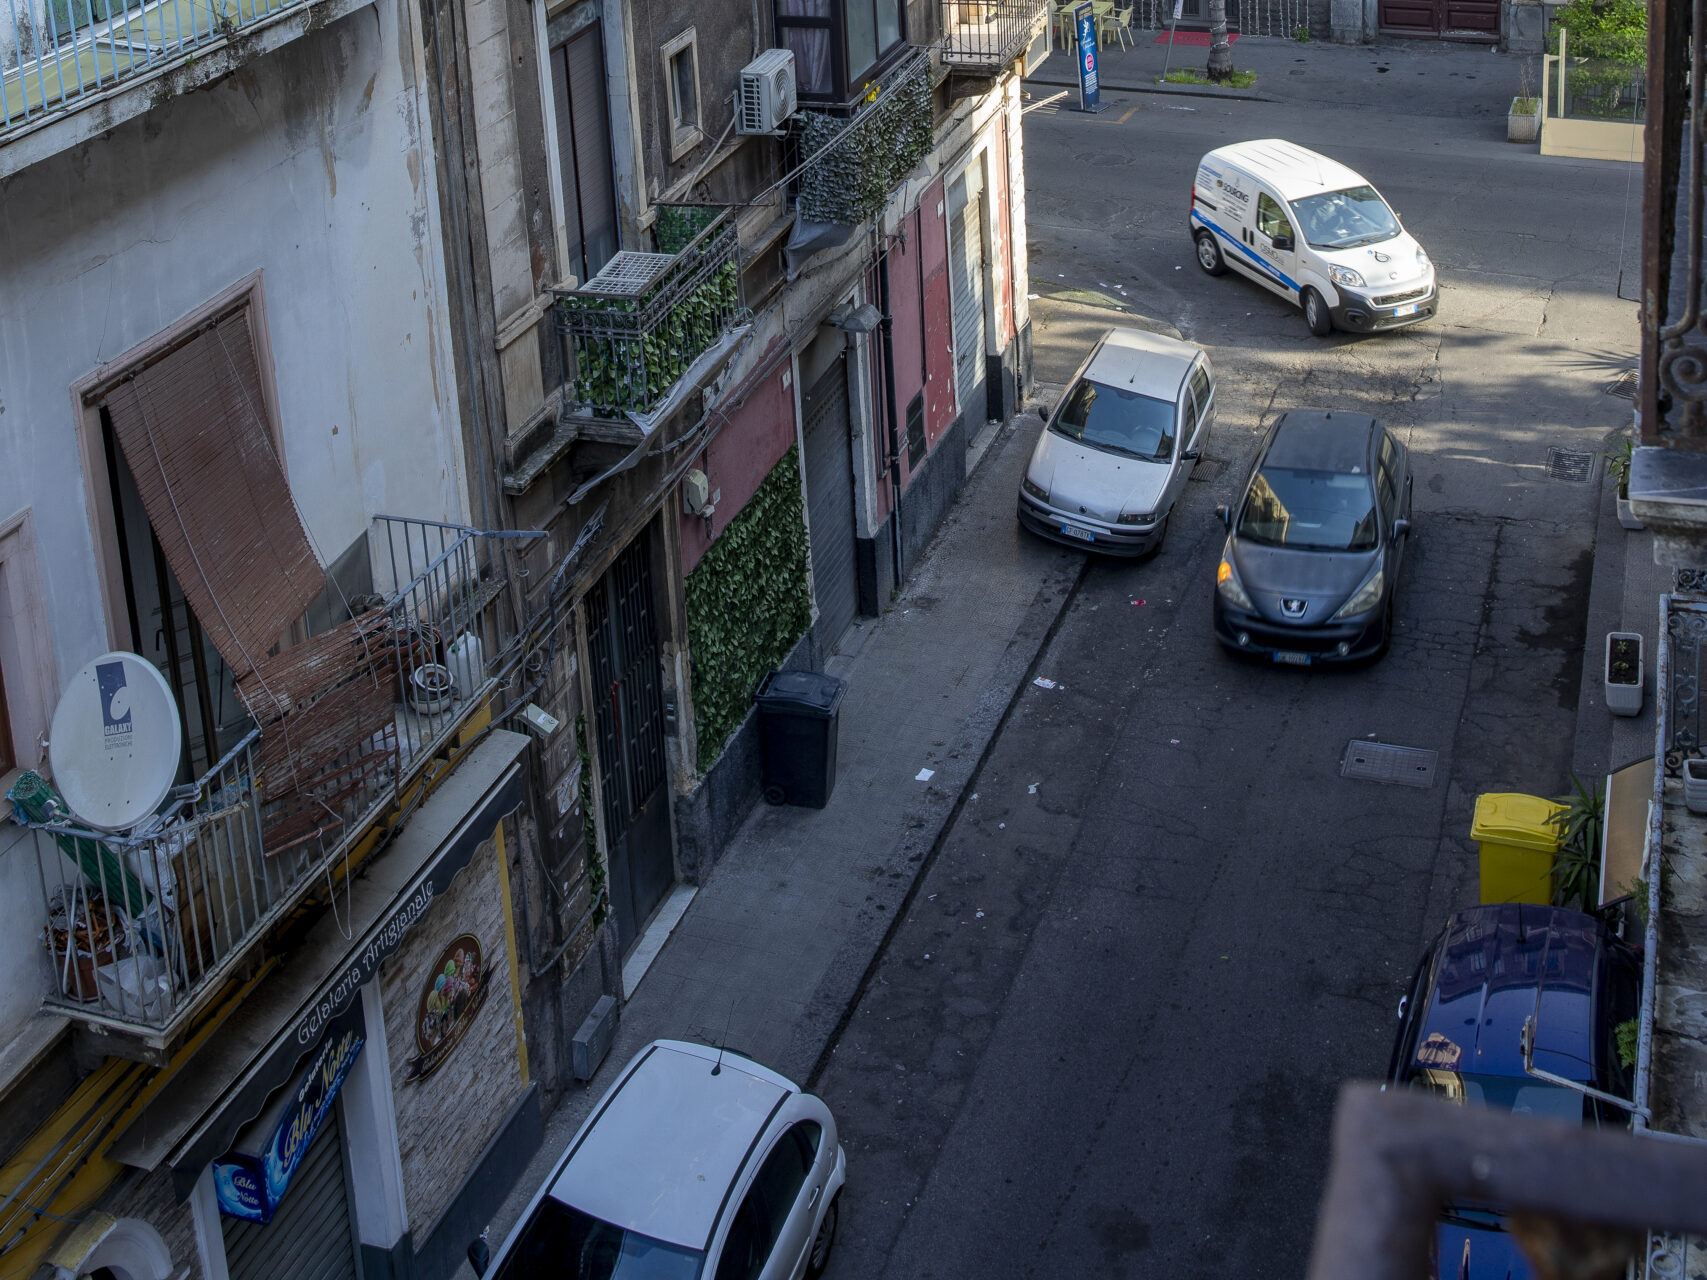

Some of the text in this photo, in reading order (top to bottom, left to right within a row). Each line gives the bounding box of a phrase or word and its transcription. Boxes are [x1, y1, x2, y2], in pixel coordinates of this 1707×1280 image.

[104, 722, 132, 736] GALAXY
[298, 967, 361, 1044] Gelateria
[362, 880, 434, 971] Artigianale
[283, 1102, 315, 1168] Blu
[315, 1030, 353, 1107] Notte
[233, 1175, 257, 1191] Blu
[236, 1191, 260, 1205] Notte
